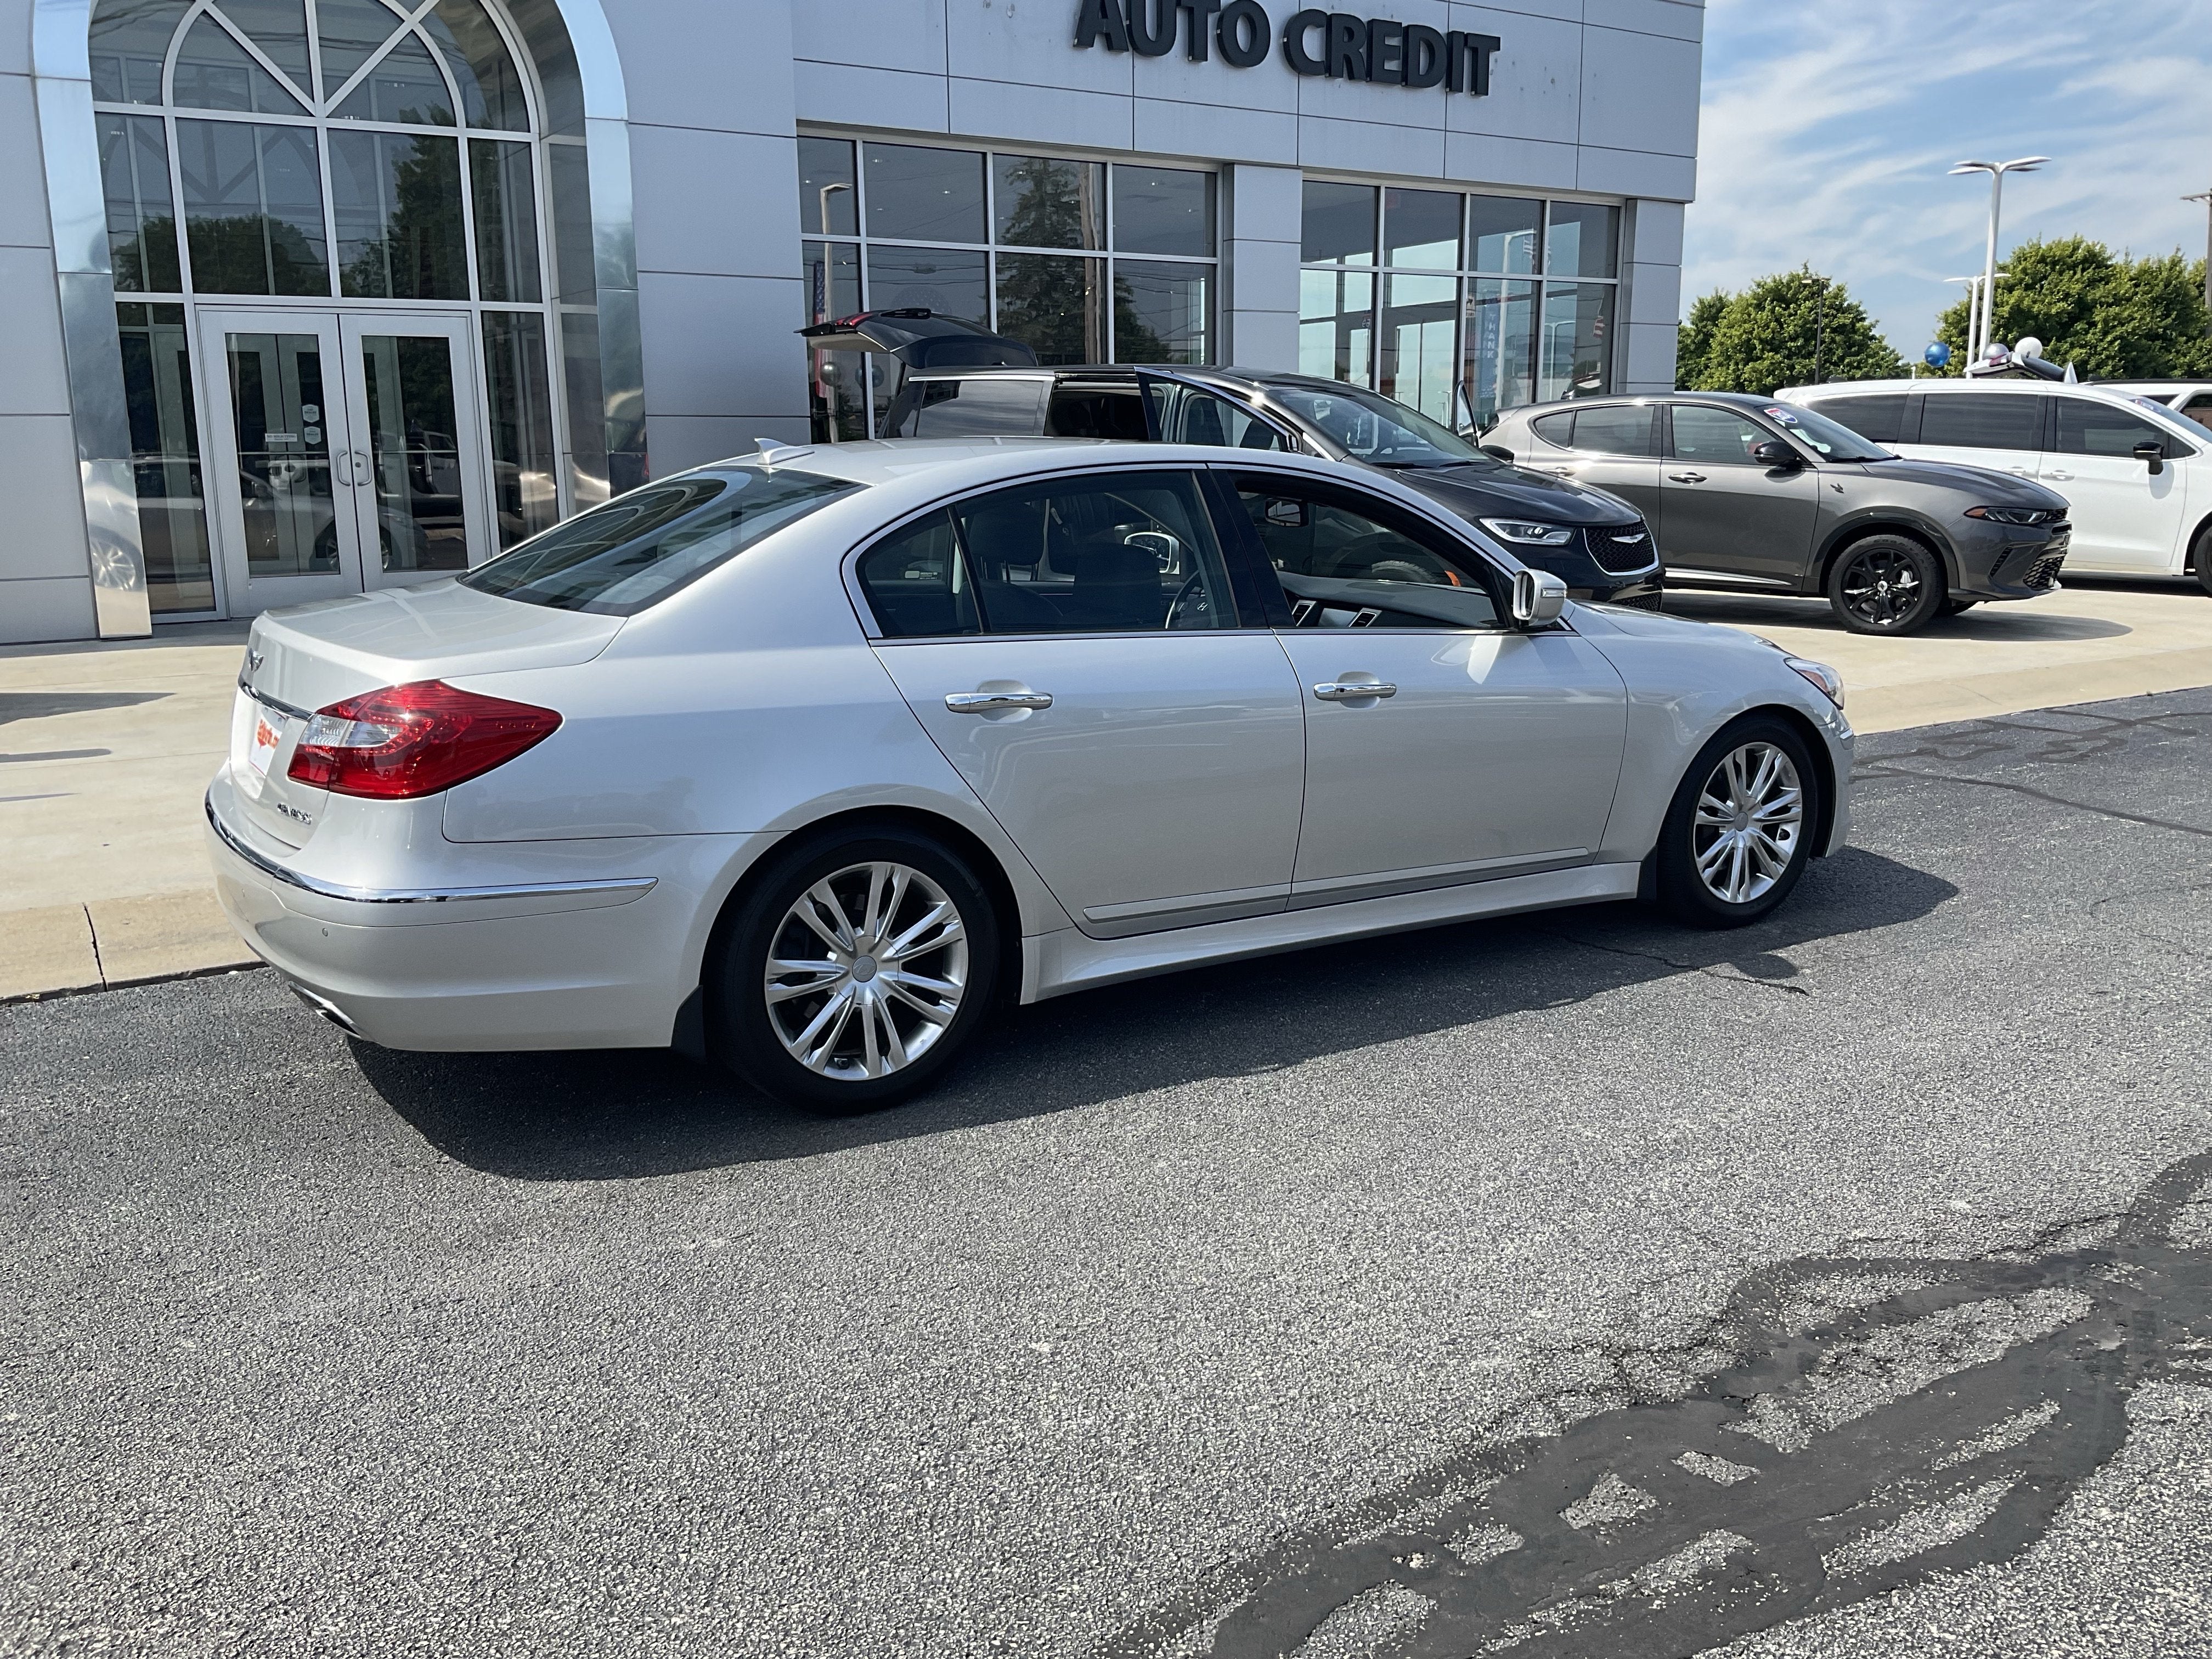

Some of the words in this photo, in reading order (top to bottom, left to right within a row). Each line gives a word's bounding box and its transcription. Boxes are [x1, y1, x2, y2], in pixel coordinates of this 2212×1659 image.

[1073, 0, 1271, 68] AUTO
[1283, 8, 1501, 97] CREDIT
[1487, 314, 1496, 358] THANK
